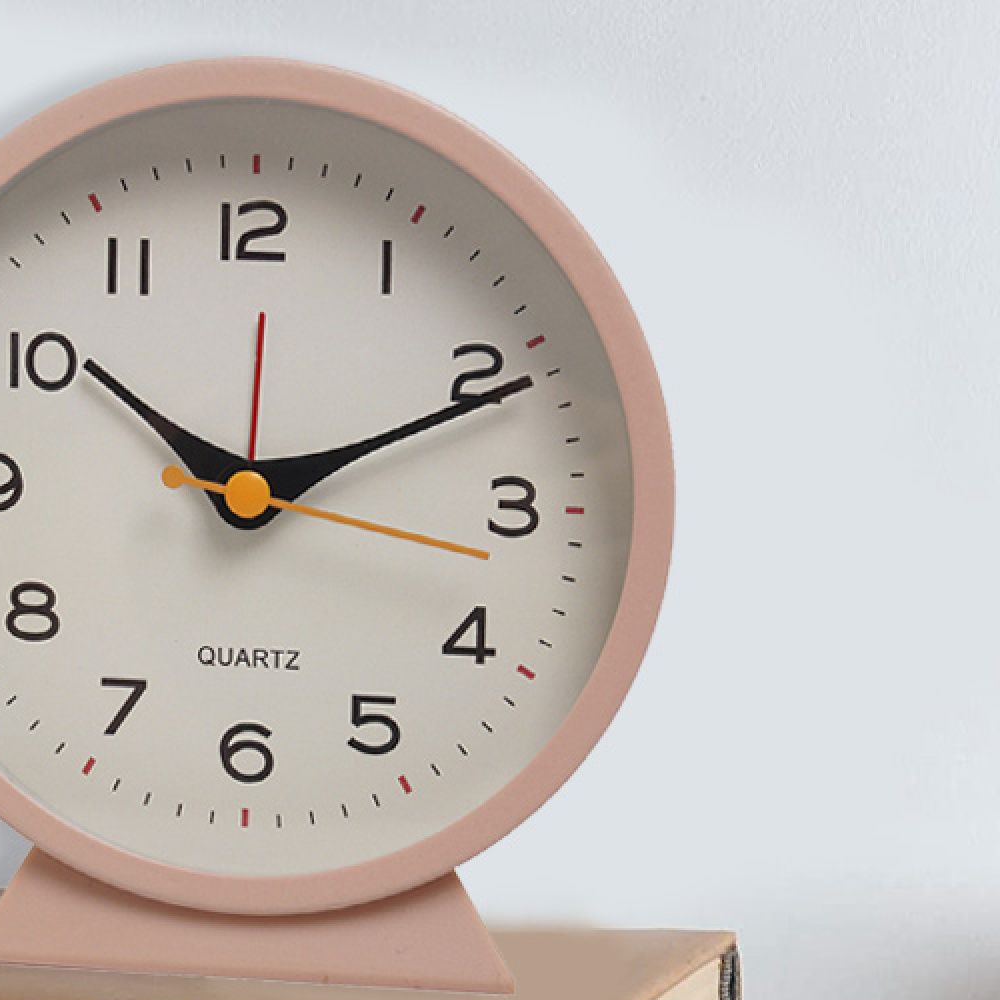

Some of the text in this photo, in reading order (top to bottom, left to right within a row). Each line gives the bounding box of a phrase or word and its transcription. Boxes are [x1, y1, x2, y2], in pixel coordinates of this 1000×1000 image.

[221, 199, 288, 262] 12
[107, 238, 149, 295] 11
[381, 240, 392, 295] 1
[9, 331, 77, 391] 10
[451, 343, 503, 404] 2
[487, 475, 539, 539] 3
[5, 581, 60, 641] 8
[441, 605, 497, 665] 4
[197, 645, 301, 671] QUARTZ
[101, 677, 147, 735] 7
[347, 693, 401, 755] 5
[219, 722, 275, 783] 6
